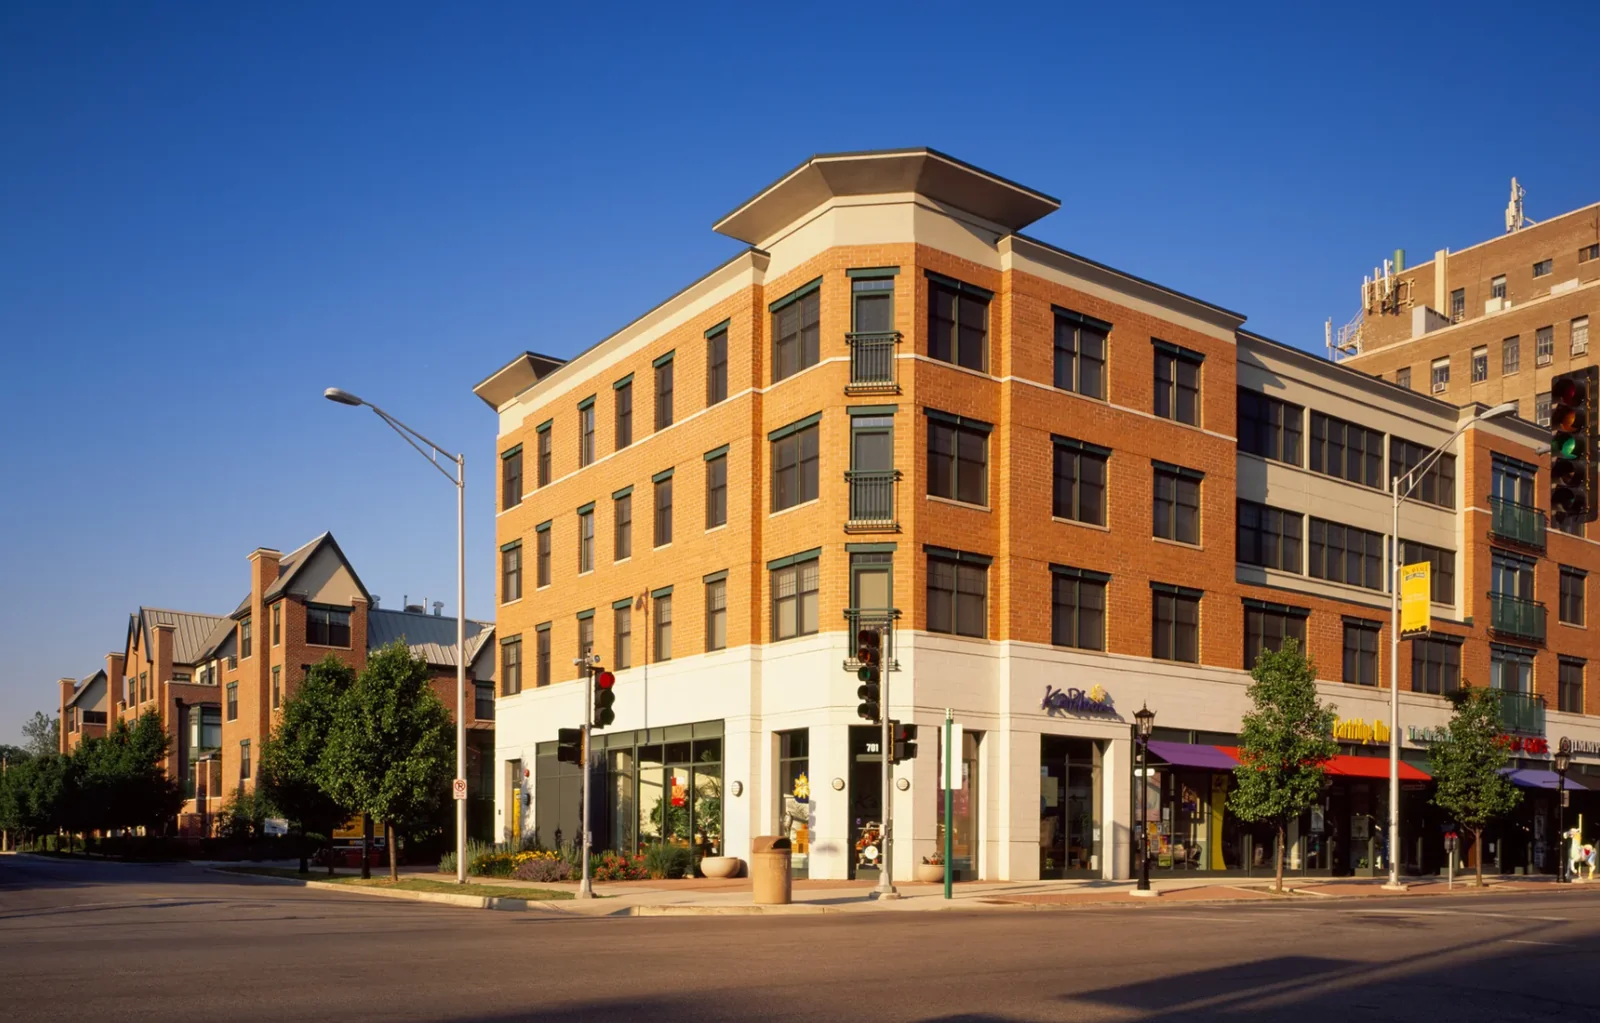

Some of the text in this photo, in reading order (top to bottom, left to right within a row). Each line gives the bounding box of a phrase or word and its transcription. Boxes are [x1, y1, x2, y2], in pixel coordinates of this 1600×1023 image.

[1332, 715, 1391, 745] Cartridge Wor
[1408, 725, 1424, 741] The
[866, 743, 879, 753] 701
[1570, 739, 1600, 753] JIMMY
